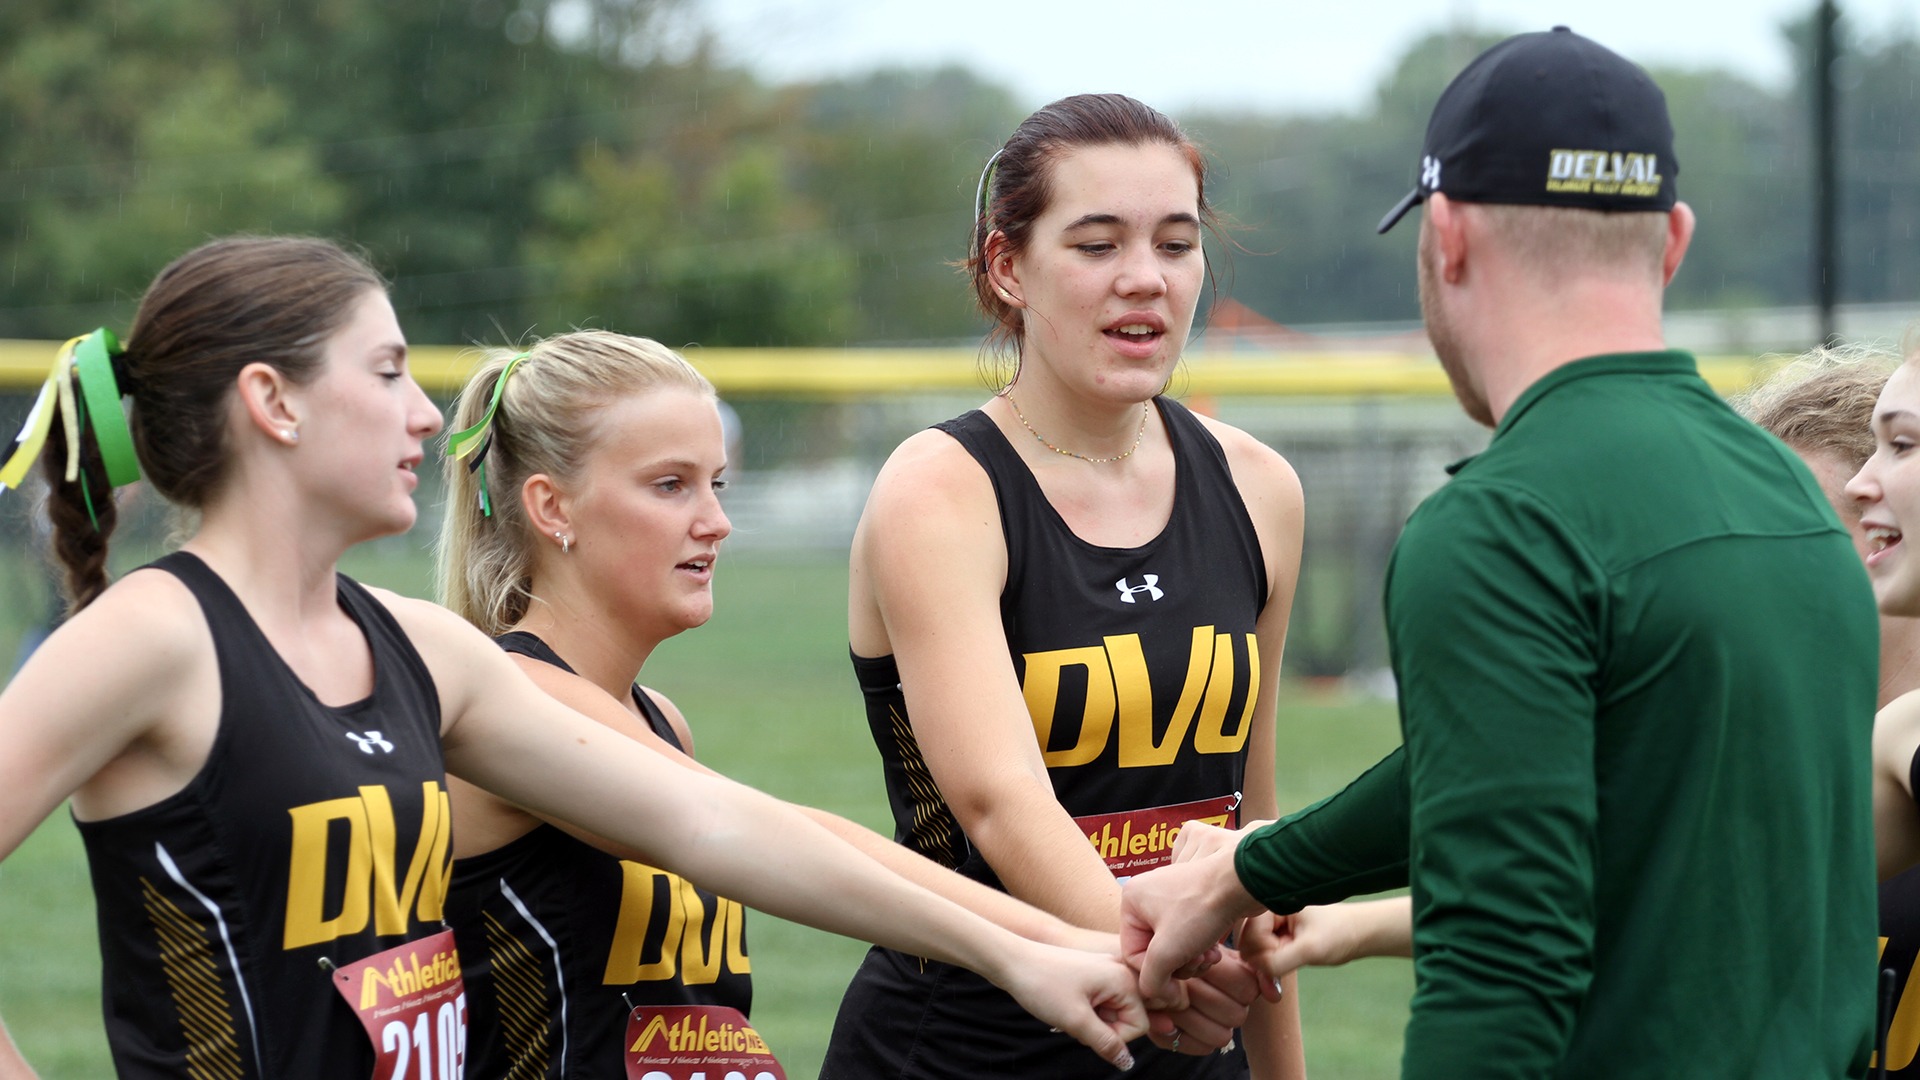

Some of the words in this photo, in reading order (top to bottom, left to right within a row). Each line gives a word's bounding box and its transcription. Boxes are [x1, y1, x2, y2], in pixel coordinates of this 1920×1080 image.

[1549, 149, 1662, 184] DELVAL
[1022, 625, 1261, 768] DVU
[1089, 820, 1179, 860] thletic
[629, 1014, 770, 1055] AthleticNE
